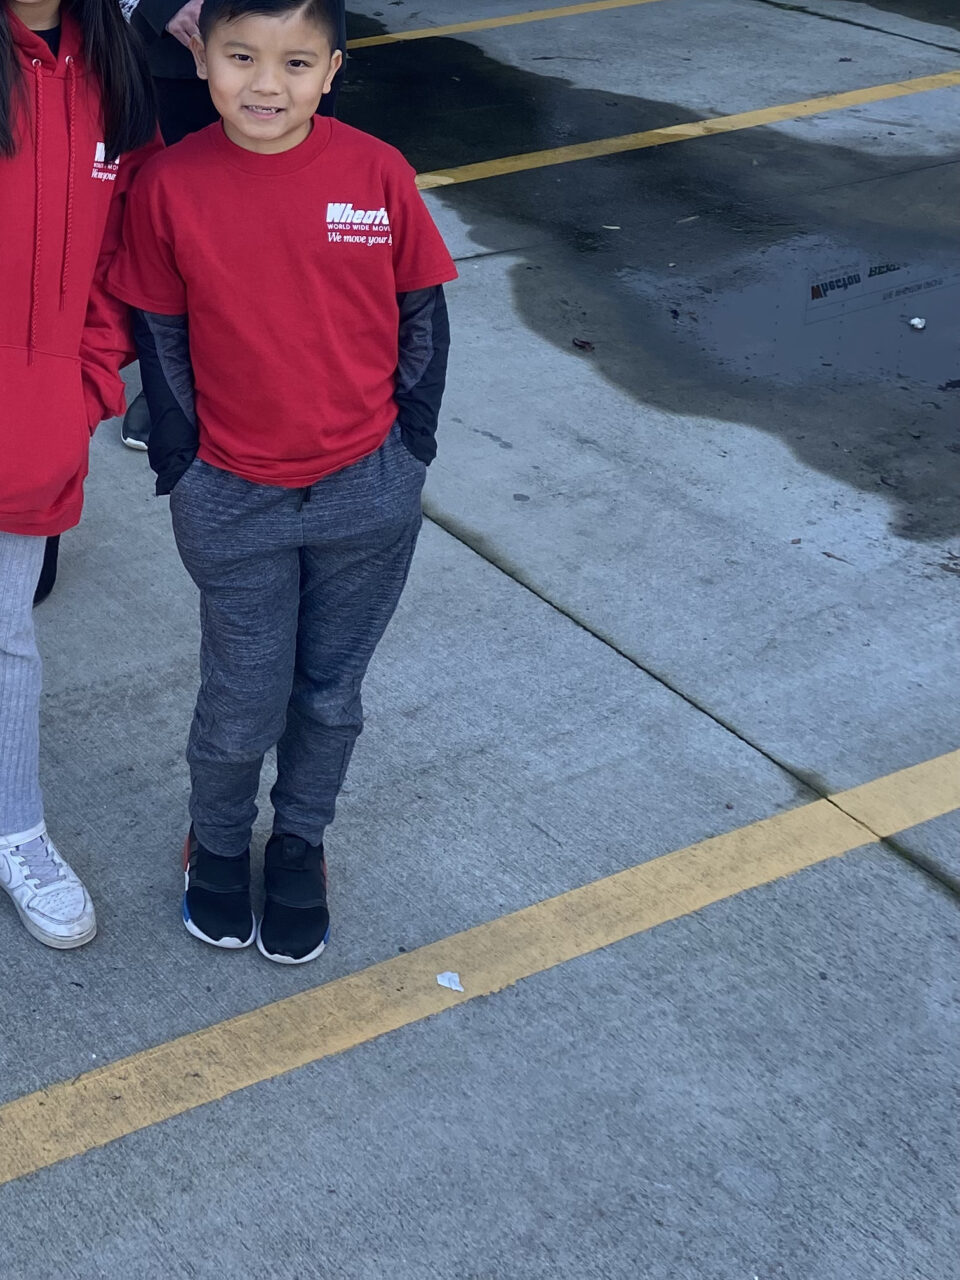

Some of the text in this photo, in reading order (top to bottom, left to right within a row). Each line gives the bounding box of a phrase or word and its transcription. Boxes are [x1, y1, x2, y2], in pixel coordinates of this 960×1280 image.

[327, 231, 342, 242] We
[343, 235, 366, 243] move
[367, 236, 387, 247] your
